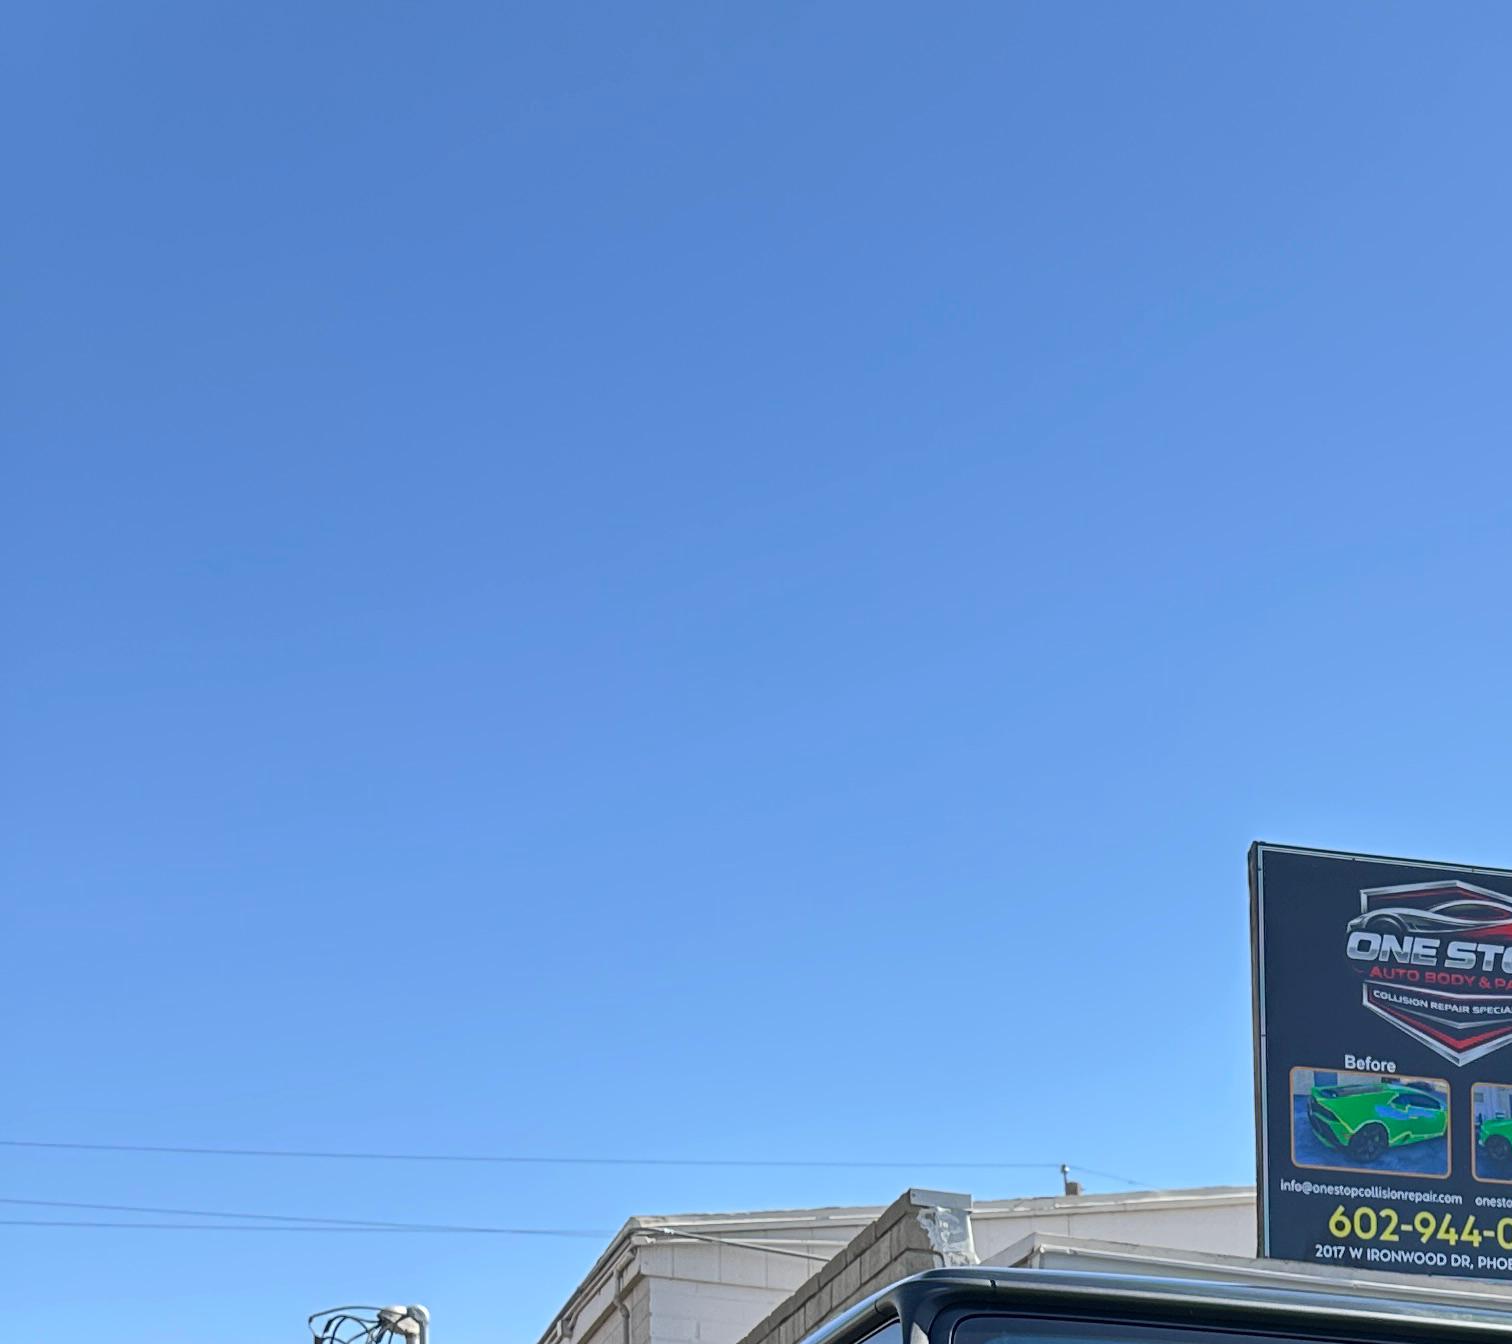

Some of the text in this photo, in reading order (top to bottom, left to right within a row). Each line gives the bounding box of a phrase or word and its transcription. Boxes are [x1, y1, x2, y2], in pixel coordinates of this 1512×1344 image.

[1346, 931, 1440, 966] ONE
[1369, 966, 1420, 982] AUTO
[1425, 971, 1476, 986] BODY
[1478, 976, 1492, 990] &
[1373, 989, 1428, 1009] COLLISION
[1430, 1000, 1471, 1014] REPAIR
[1344, 1054, 1397, 1073] Before
[1280, 1178, 1463, 1205] info@onestopcollisionrepair.com
[1315, 1244, 1346, 1259] 2017
[1349, 1246, 1363, 1260] W
[1367, 1248, 1447, 1266] IRONWOOD
[1451, 1254, 1474, 1270] DR,
